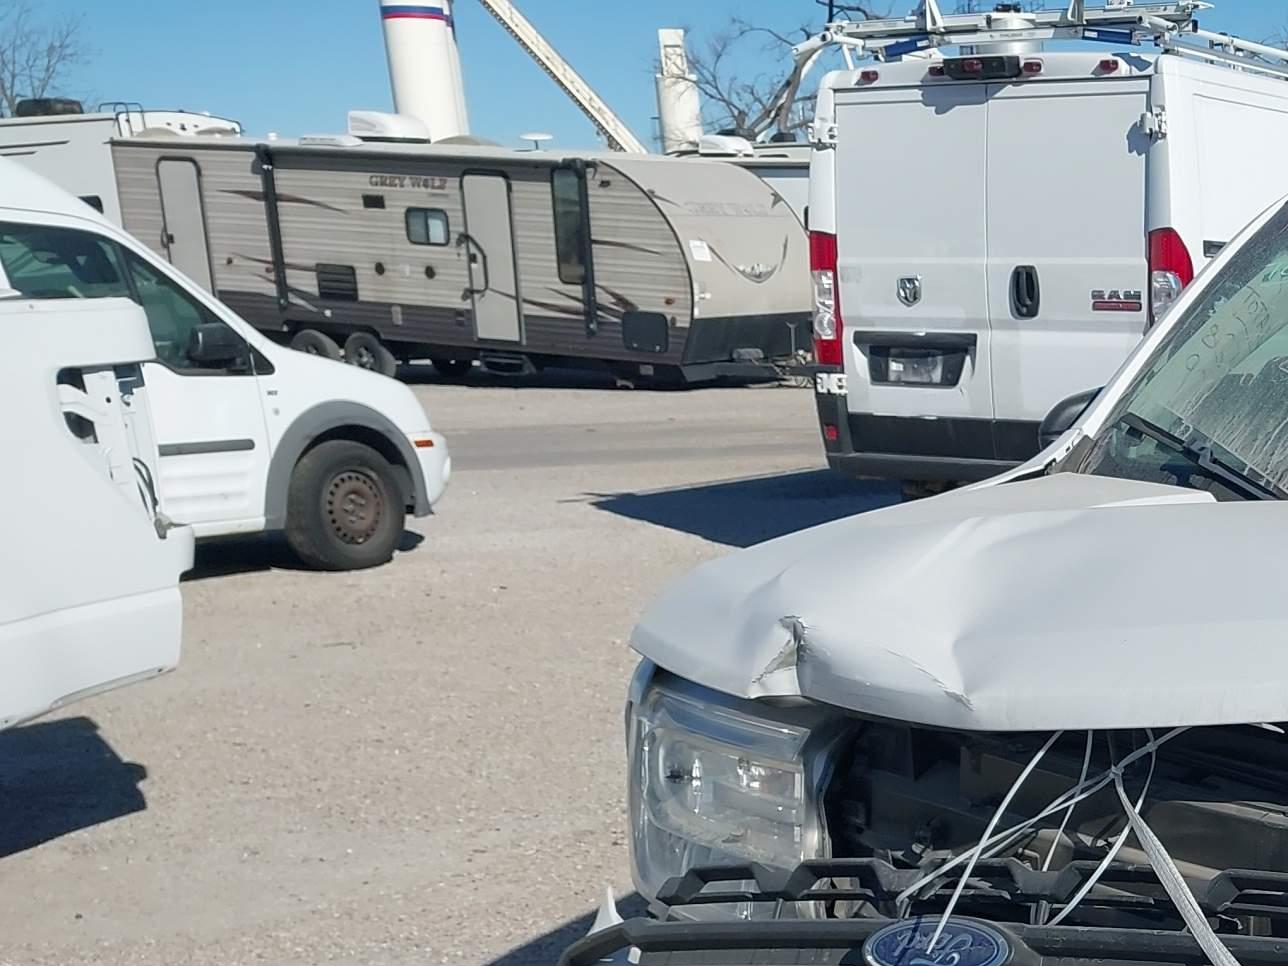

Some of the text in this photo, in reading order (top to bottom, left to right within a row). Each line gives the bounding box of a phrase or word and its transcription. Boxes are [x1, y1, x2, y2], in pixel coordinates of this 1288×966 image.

[369, 175, 448, 190] GREY WOLF
[1091, 290, 1142, 300] RAM
